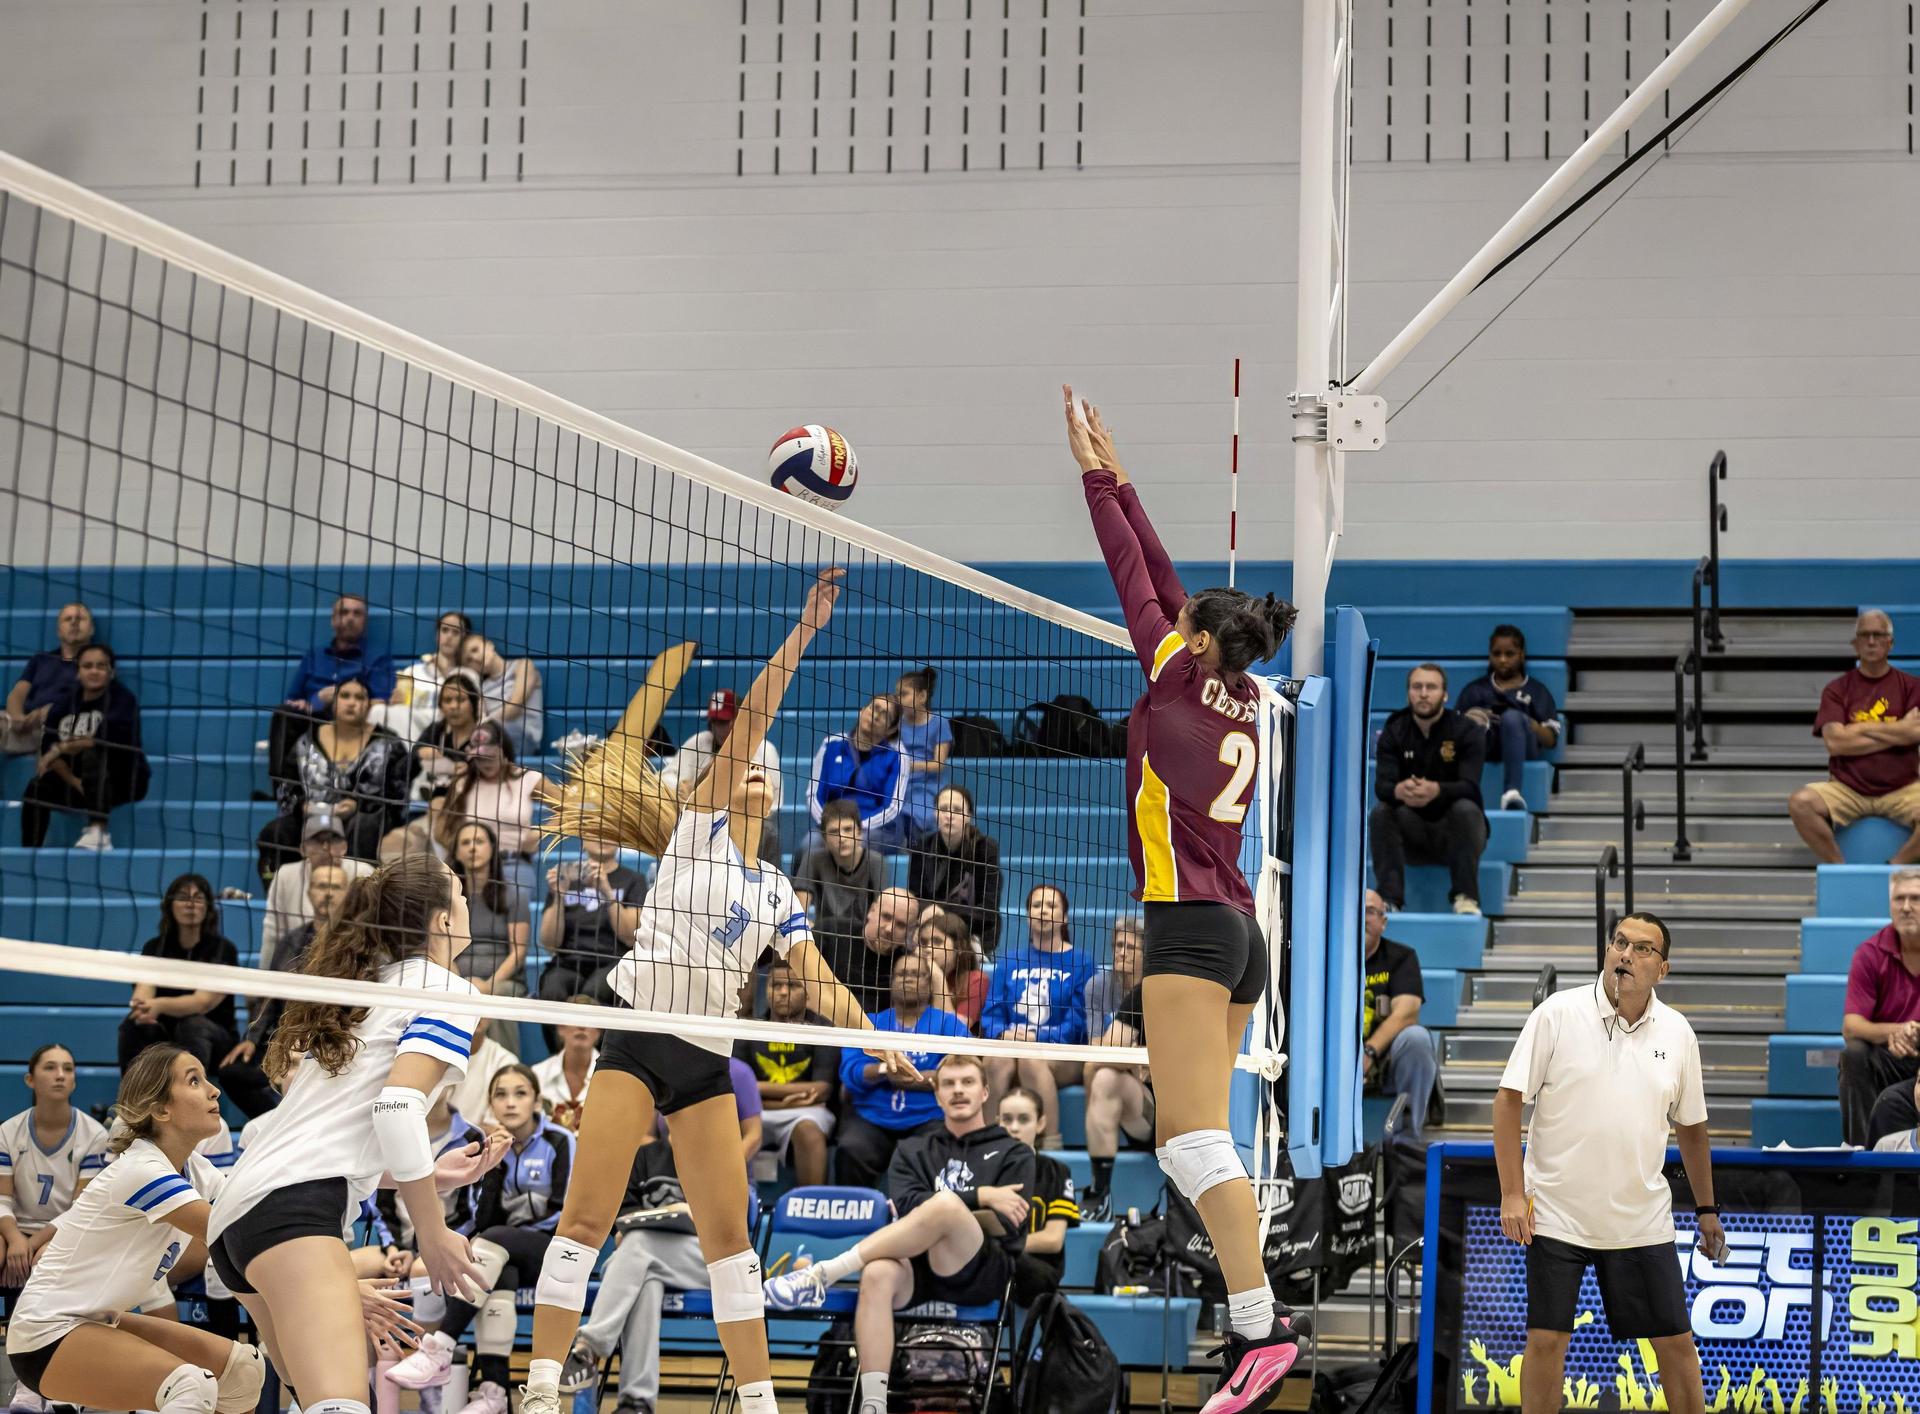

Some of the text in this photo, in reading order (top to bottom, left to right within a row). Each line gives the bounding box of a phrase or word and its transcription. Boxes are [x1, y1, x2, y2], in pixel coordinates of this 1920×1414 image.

[1209, 731, 1256, 823] 2
[712, 900, 751, 948] 3
[37, 1174, 54, 1205] 7
[786, 1197, 875, 1220] REAGAN
[1849, 1216, 1919, 1360] YOUR
